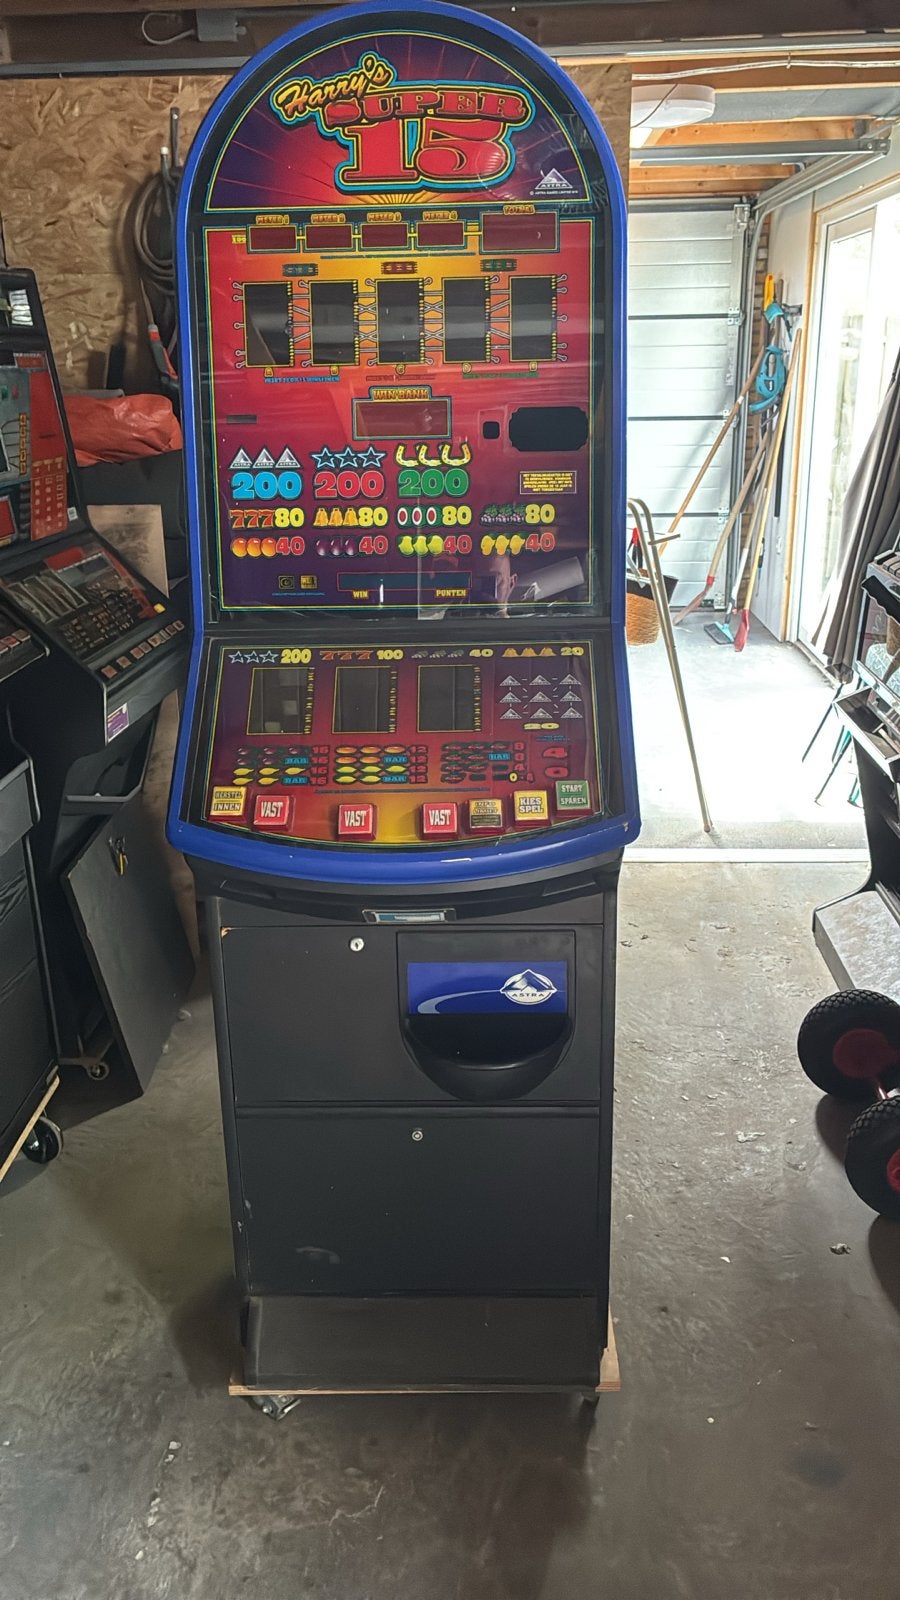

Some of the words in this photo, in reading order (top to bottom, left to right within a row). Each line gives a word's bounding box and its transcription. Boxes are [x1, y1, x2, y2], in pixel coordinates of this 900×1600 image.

[276, 57, 392, 113] Harry's
[326, 90, 527, 125] SUPER
[343, 117, 505, 180] 15
[373, 389, 396, 400] WIN
[398, 388, 429, 400] BANK
[230, 470, 303, 500] 200
[314, 470, 385, 499] 200
[399, 468, 470, 497] 200
[274, 507, 305, 528] 80
[358, 506, 389, 528] 80
[442, 505, 472, 526] 80
[525, 503, 556, 524] 80
[275, 535, 305, 556] 40
[359, 535, 389, 555] 40
[444, 534, 472, 554] 40
[526, 532, 556, 552] 40
[353, 590, 369, 599] WIN
[436, 589, 466, 598] PUNTEN
[280, 648, 312, 664] 200
[376, 649, 404, 661] 100
[469, 648, 494, 658] 40
[561, 784, 583, 793] START
[214, 802, 241, 811] INNEN
[261, 801, 284, 818] VAST
[519, 797, 542, 806] KIES
[519, 805, 544, 814] SPEL
[560, 796, 587, 805] SPAREN
[344, 810, 367, 827] VAST
[428, 809, 452, 826] VAST
